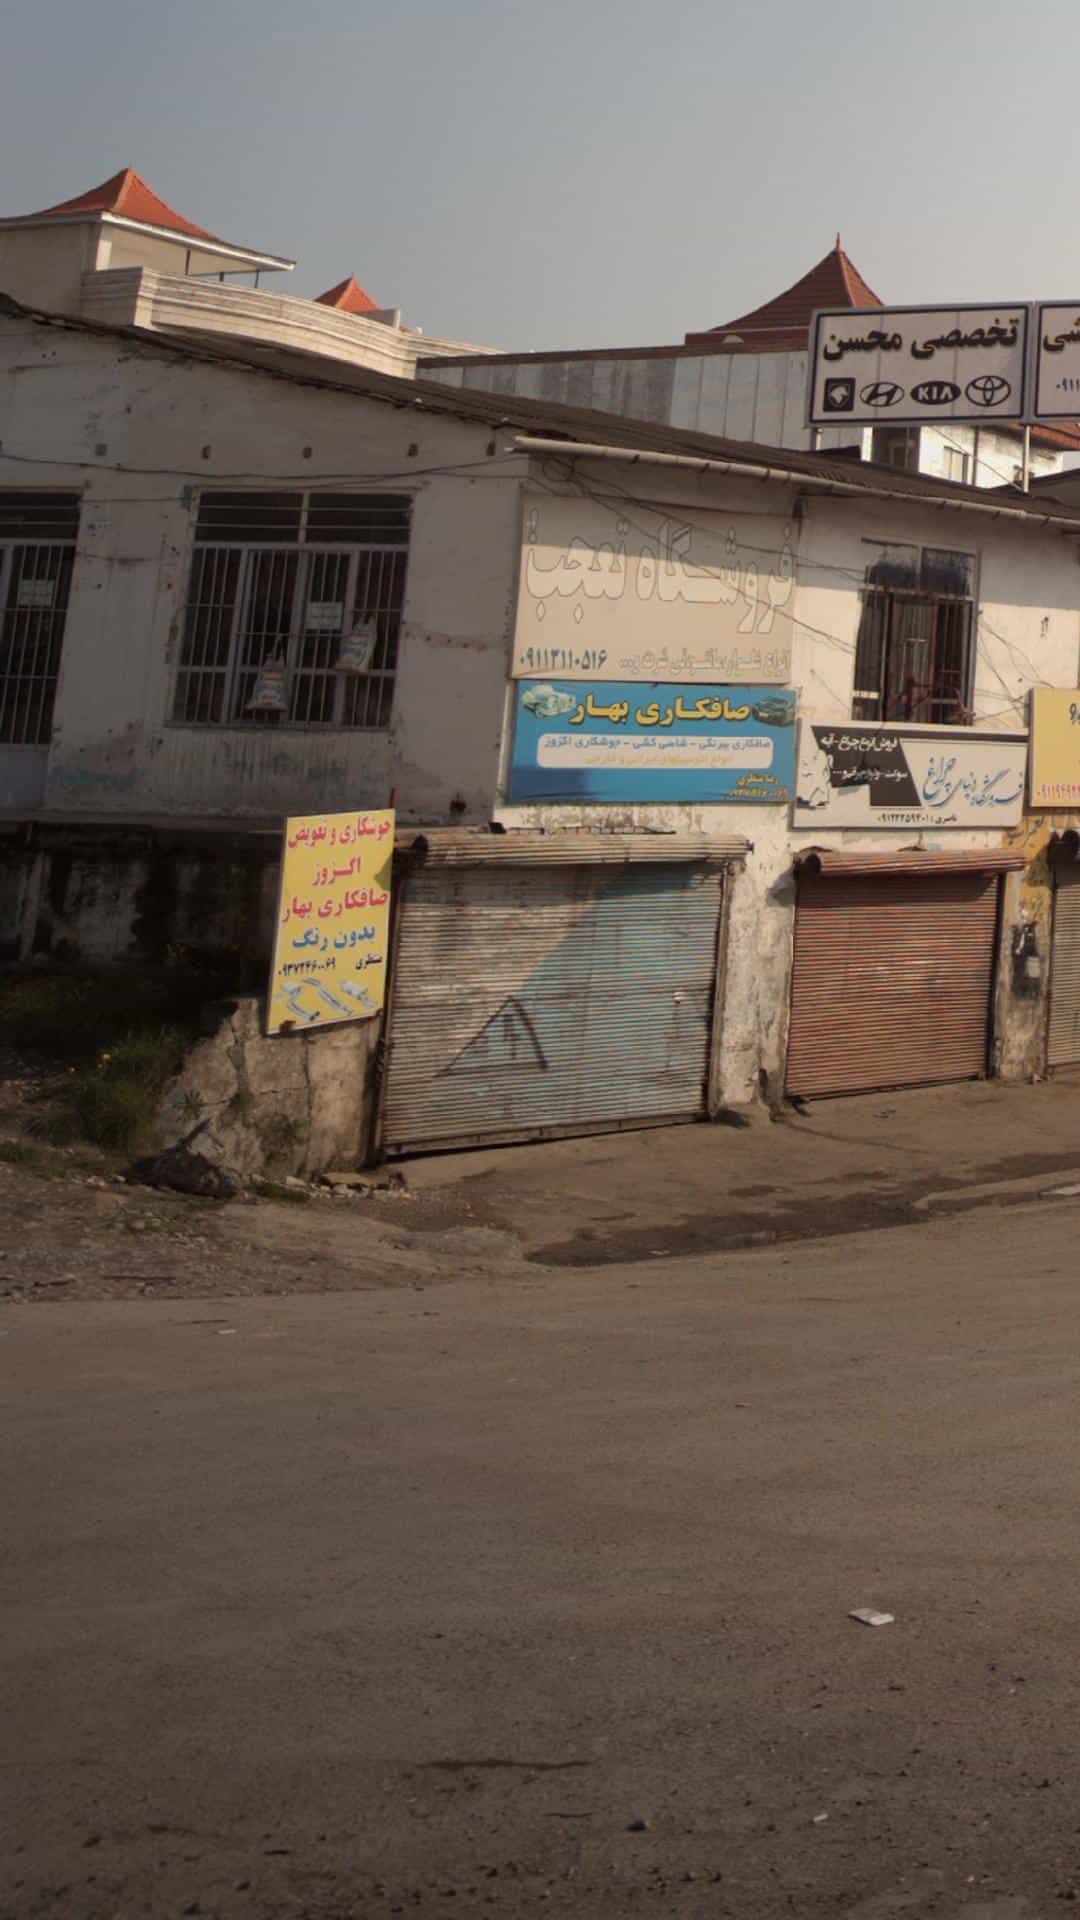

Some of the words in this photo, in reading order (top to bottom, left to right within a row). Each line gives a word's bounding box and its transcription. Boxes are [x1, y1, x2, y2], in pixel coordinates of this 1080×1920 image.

[823, 330, 903, 361] محسن
[911, 317, 1019, 359] تخصصی
[916, 384, 954, 400] KIA
[636, 514, 794, 634] فروشگاه
[568, 691, 630, 725] بهار
[635, 696, 750, 727] صافکاری
[281, 896, 313, 923] بهار
[317, 888, 389, 919] صافکاری
[291, 927, 329, 952] رنگ
[333, 924, 376, 950] بدون
